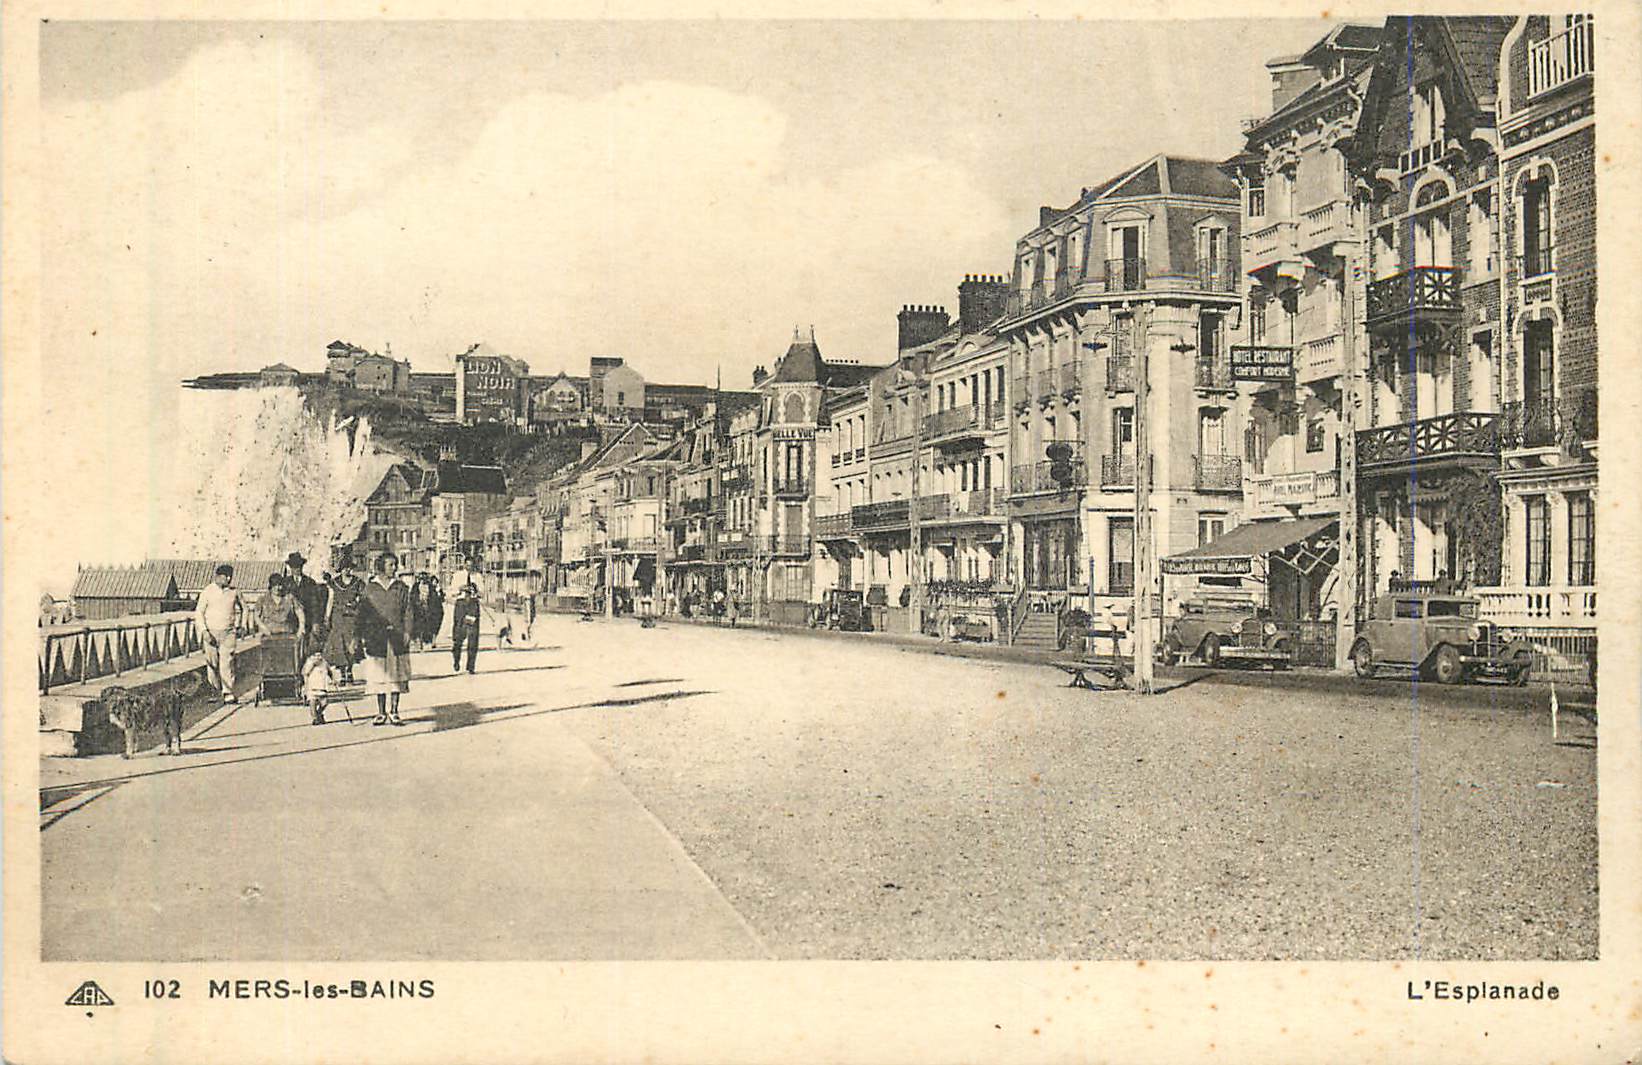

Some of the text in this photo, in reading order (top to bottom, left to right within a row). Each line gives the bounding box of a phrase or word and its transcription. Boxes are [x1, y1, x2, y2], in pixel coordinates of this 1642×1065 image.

[1253, 350, 1291, 364] RESTAURANT
[466, 361, 501, 374] LION
[477, 376, 515, 389] NOIR
